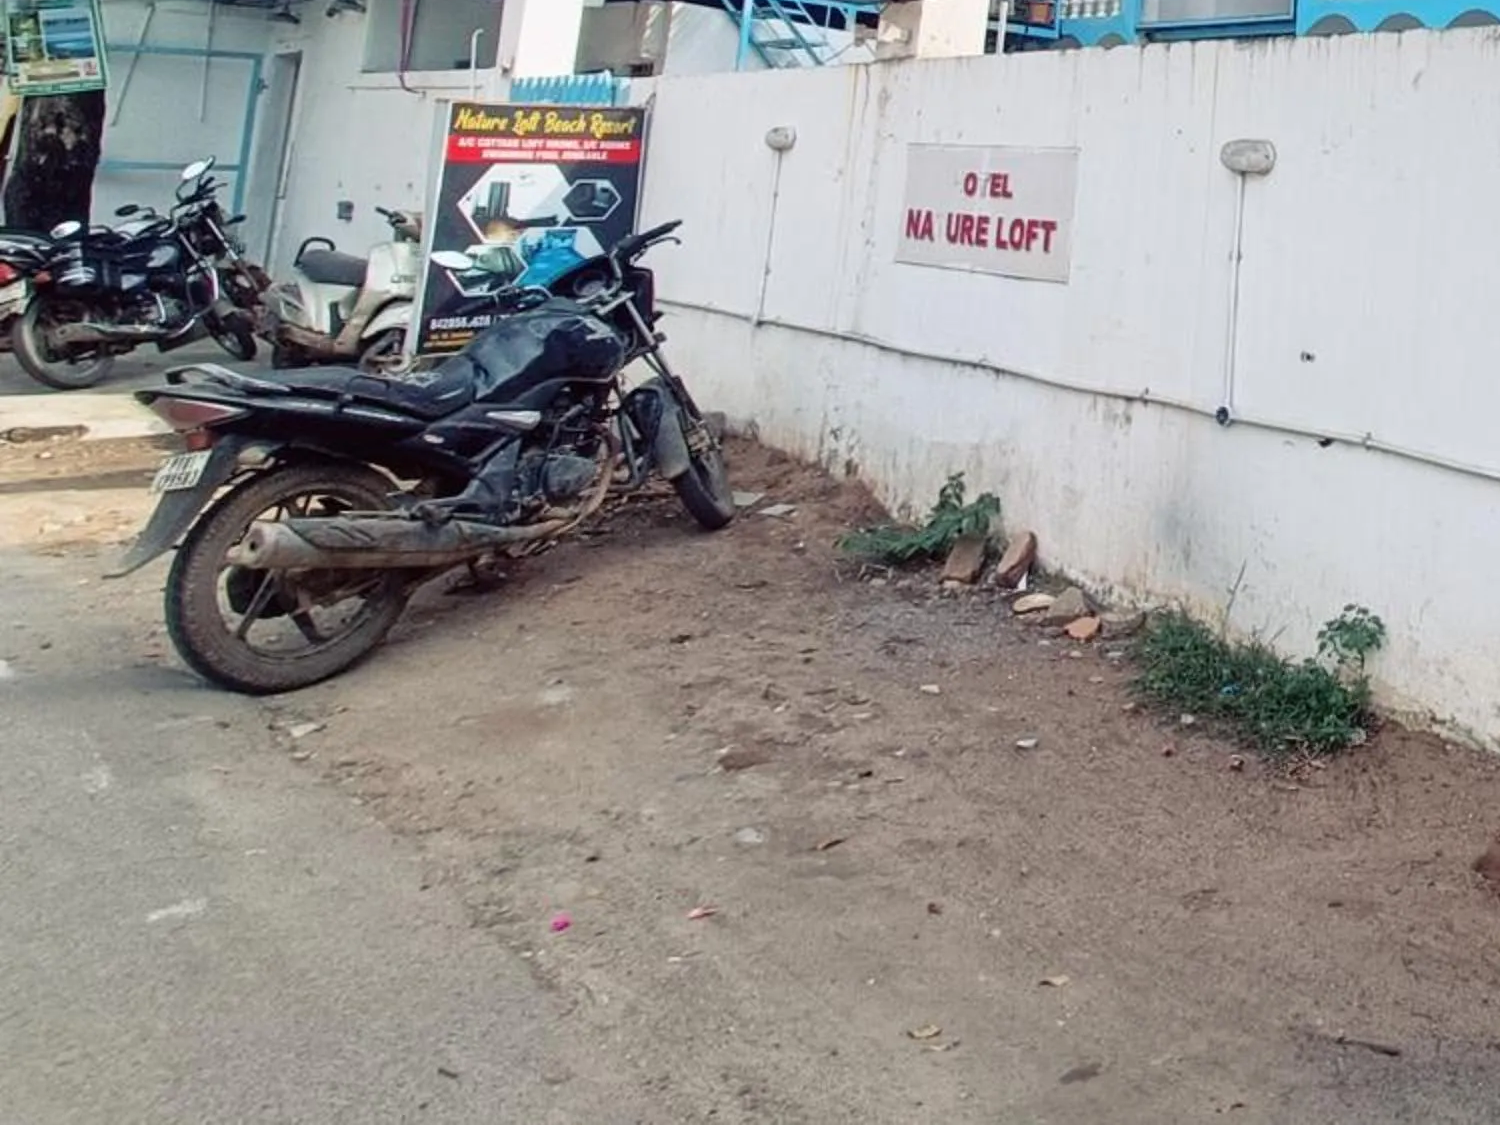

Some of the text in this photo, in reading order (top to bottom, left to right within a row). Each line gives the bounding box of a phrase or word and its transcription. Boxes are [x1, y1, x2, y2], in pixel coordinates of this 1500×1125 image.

[453, 107, 638, 139] Nature Loft Beach Resort
[995, 216, 1058, 254] LOFT
